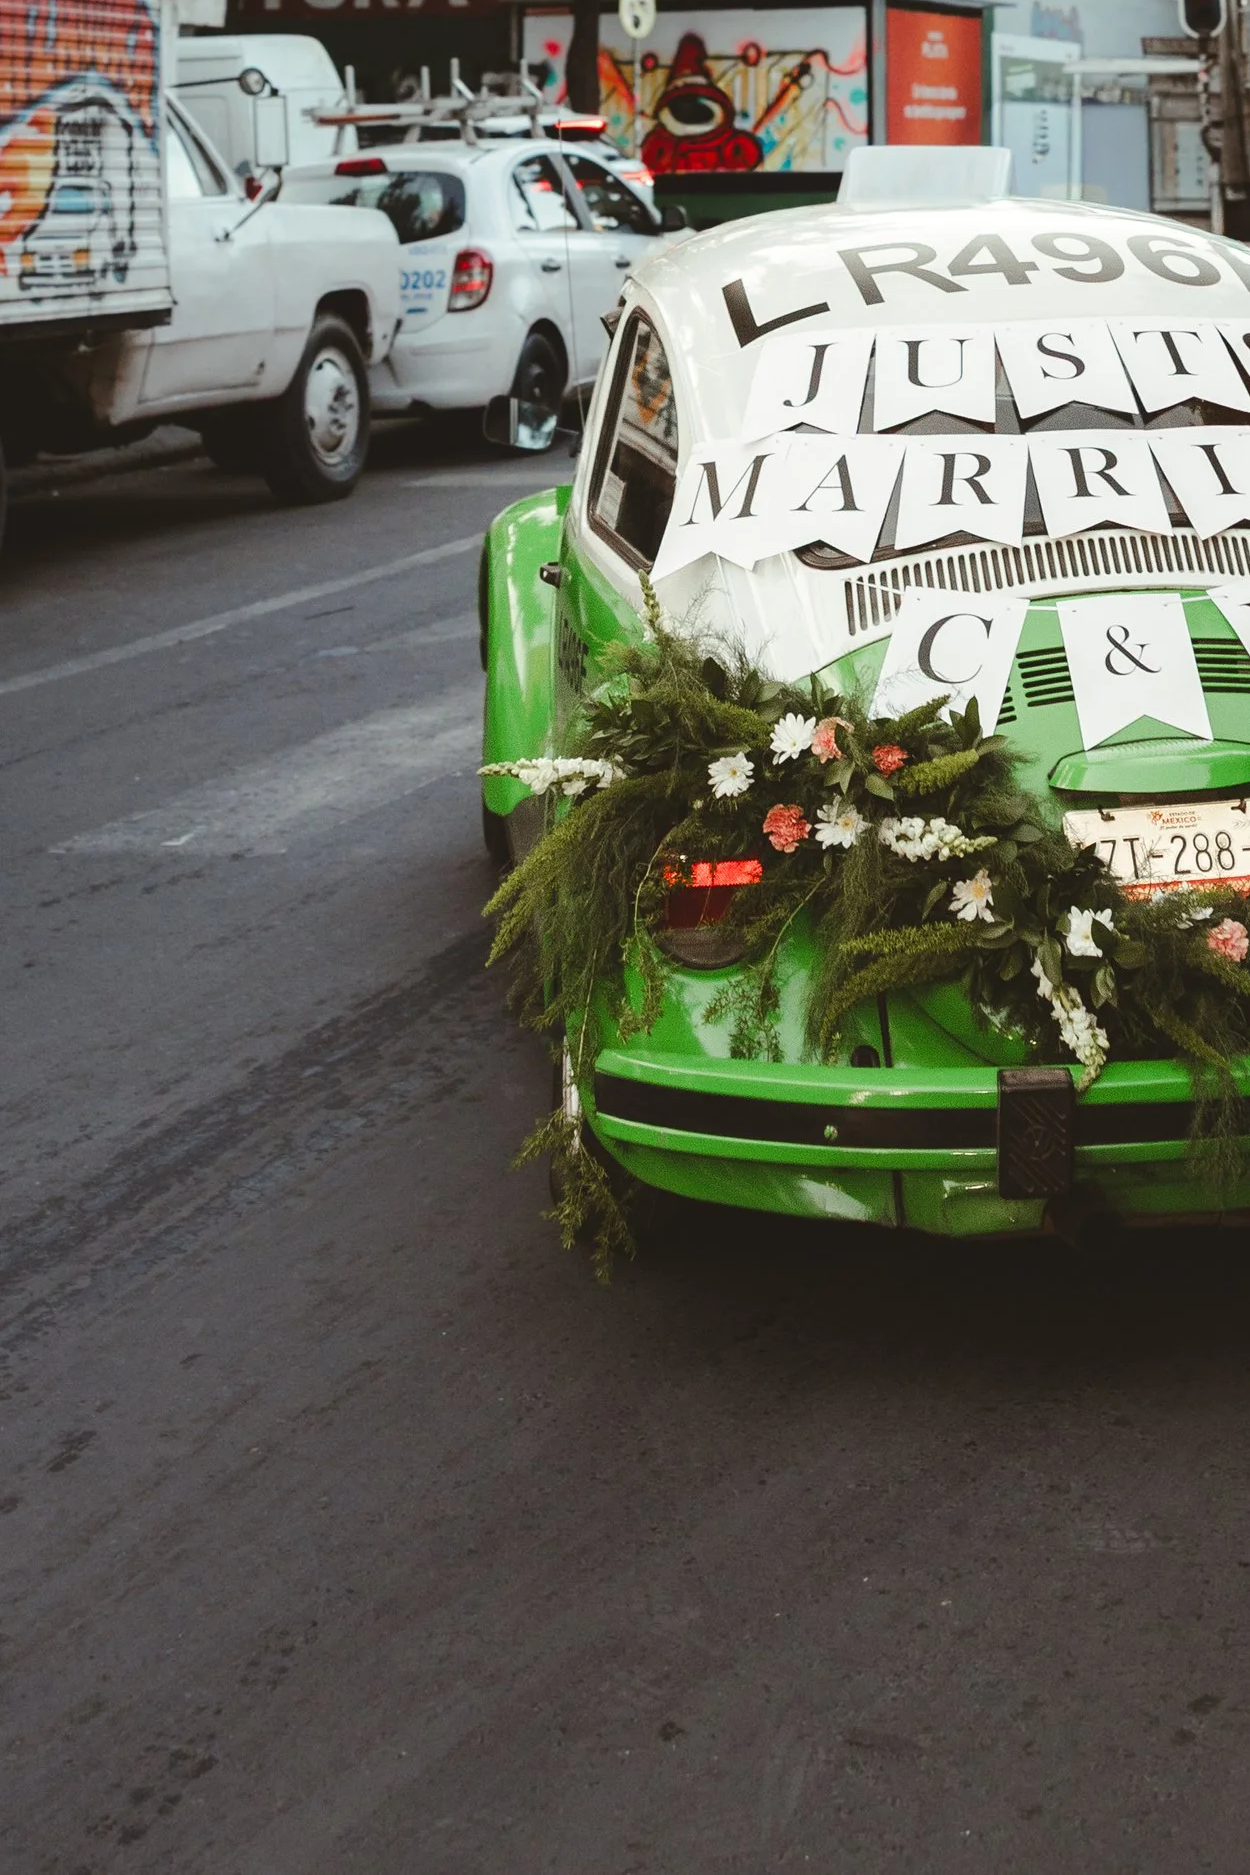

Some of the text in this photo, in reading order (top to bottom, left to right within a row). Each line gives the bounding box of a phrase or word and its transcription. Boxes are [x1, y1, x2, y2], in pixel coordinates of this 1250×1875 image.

[783, 330, 1201, 408] JUST
[917, 613, 994, 685] C
[1104, 624, 1162, 676] &
